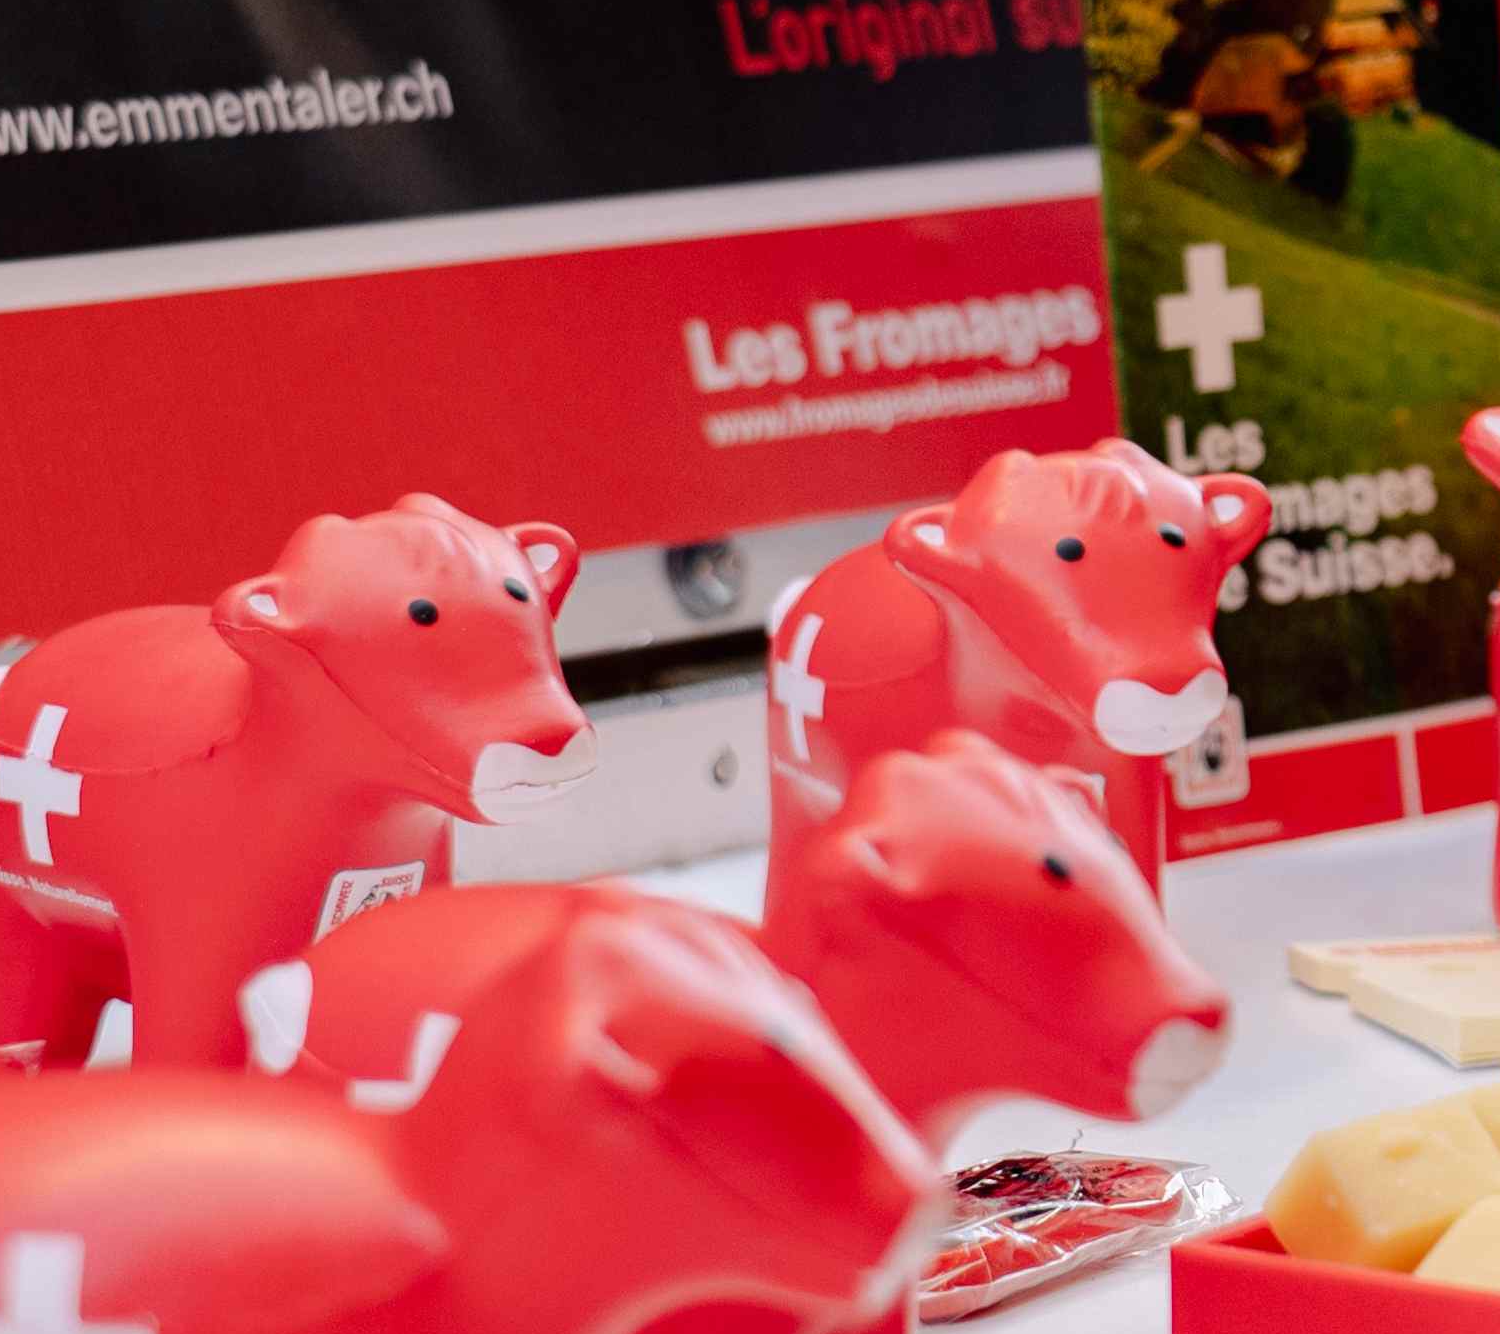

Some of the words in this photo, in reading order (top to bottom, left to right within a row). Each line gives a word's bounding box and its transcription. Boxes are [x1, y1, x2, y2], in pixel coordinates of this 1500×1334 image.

[683, 316, 806, 394] Les
[808, 284, 1101, 378] Fromages
[1164, 414, 1266, 475] Les
[1269, 465, 1437, 536] mages
